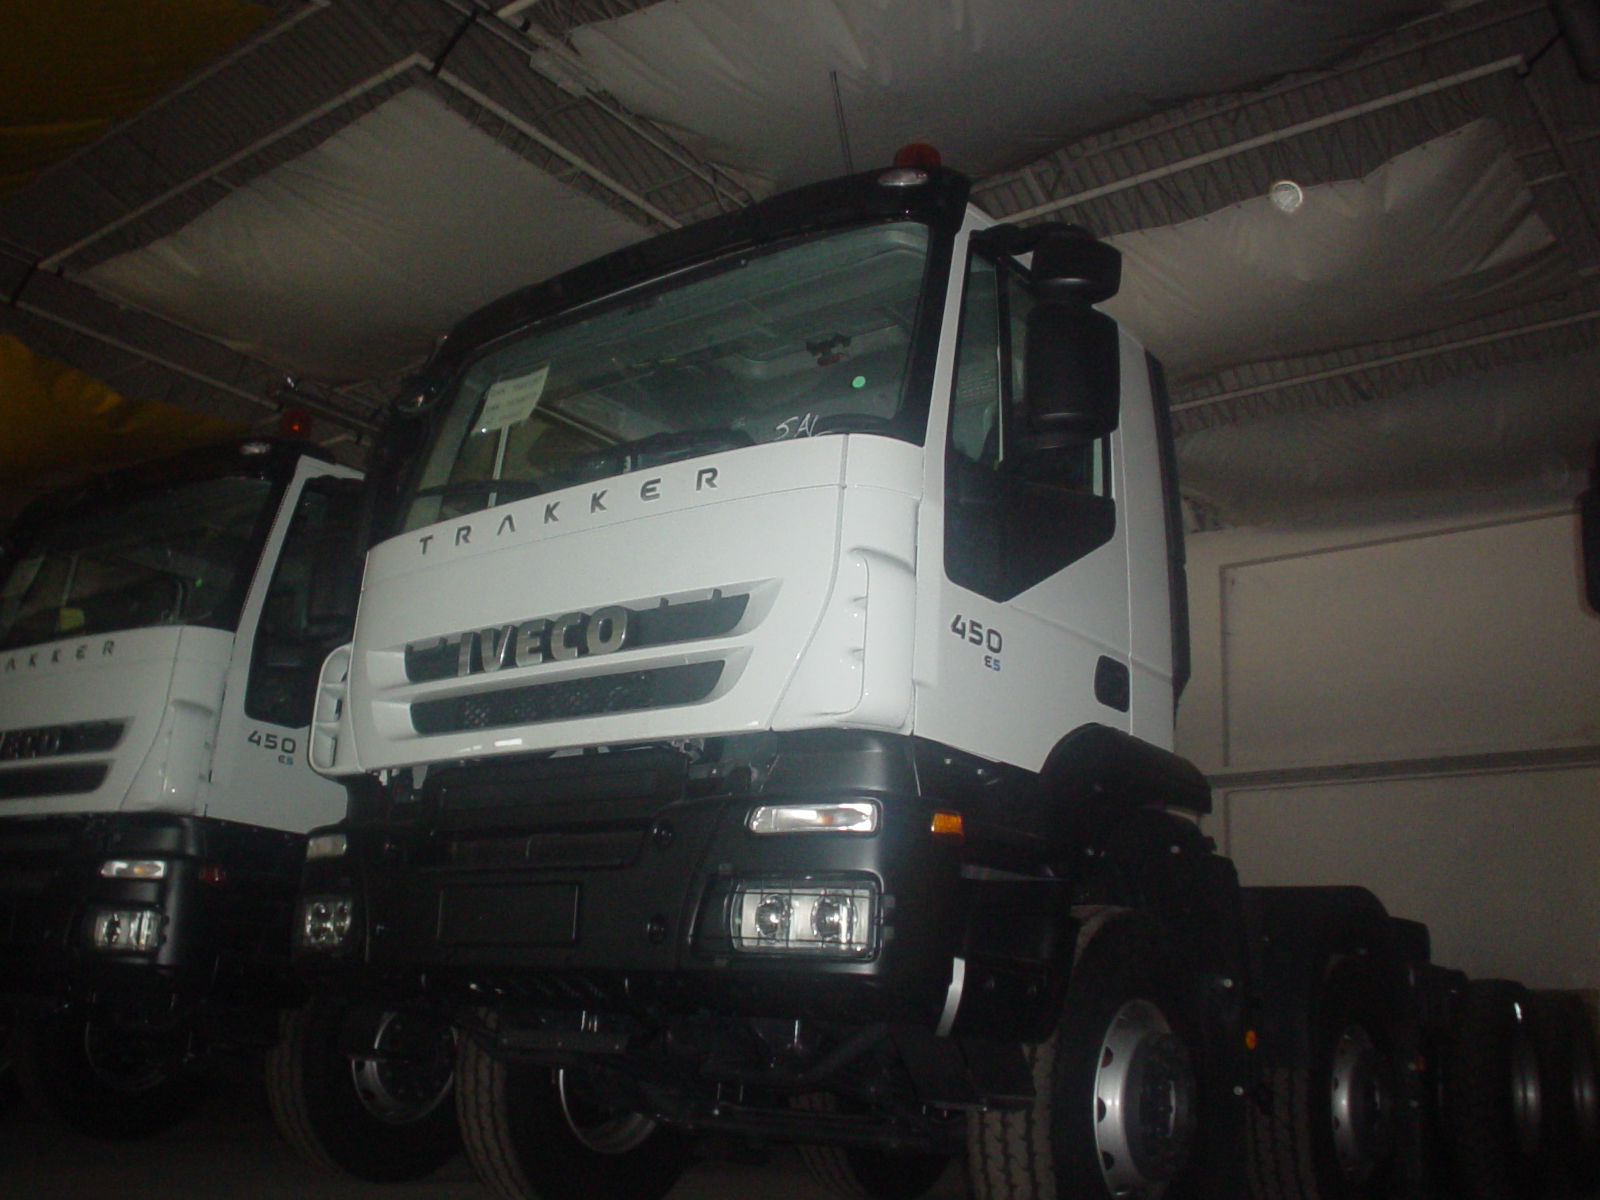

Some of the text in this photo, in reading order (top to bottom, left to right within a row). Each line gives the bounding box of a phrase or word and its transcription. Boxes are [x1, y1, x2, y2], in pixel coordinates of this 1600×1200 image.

[418, 466, 719, 556] TRAKKER
[456, 604, 630, 677] IVECO
[950, 613, 1002, 654] 450
[247, 730, 297, 754] 450
